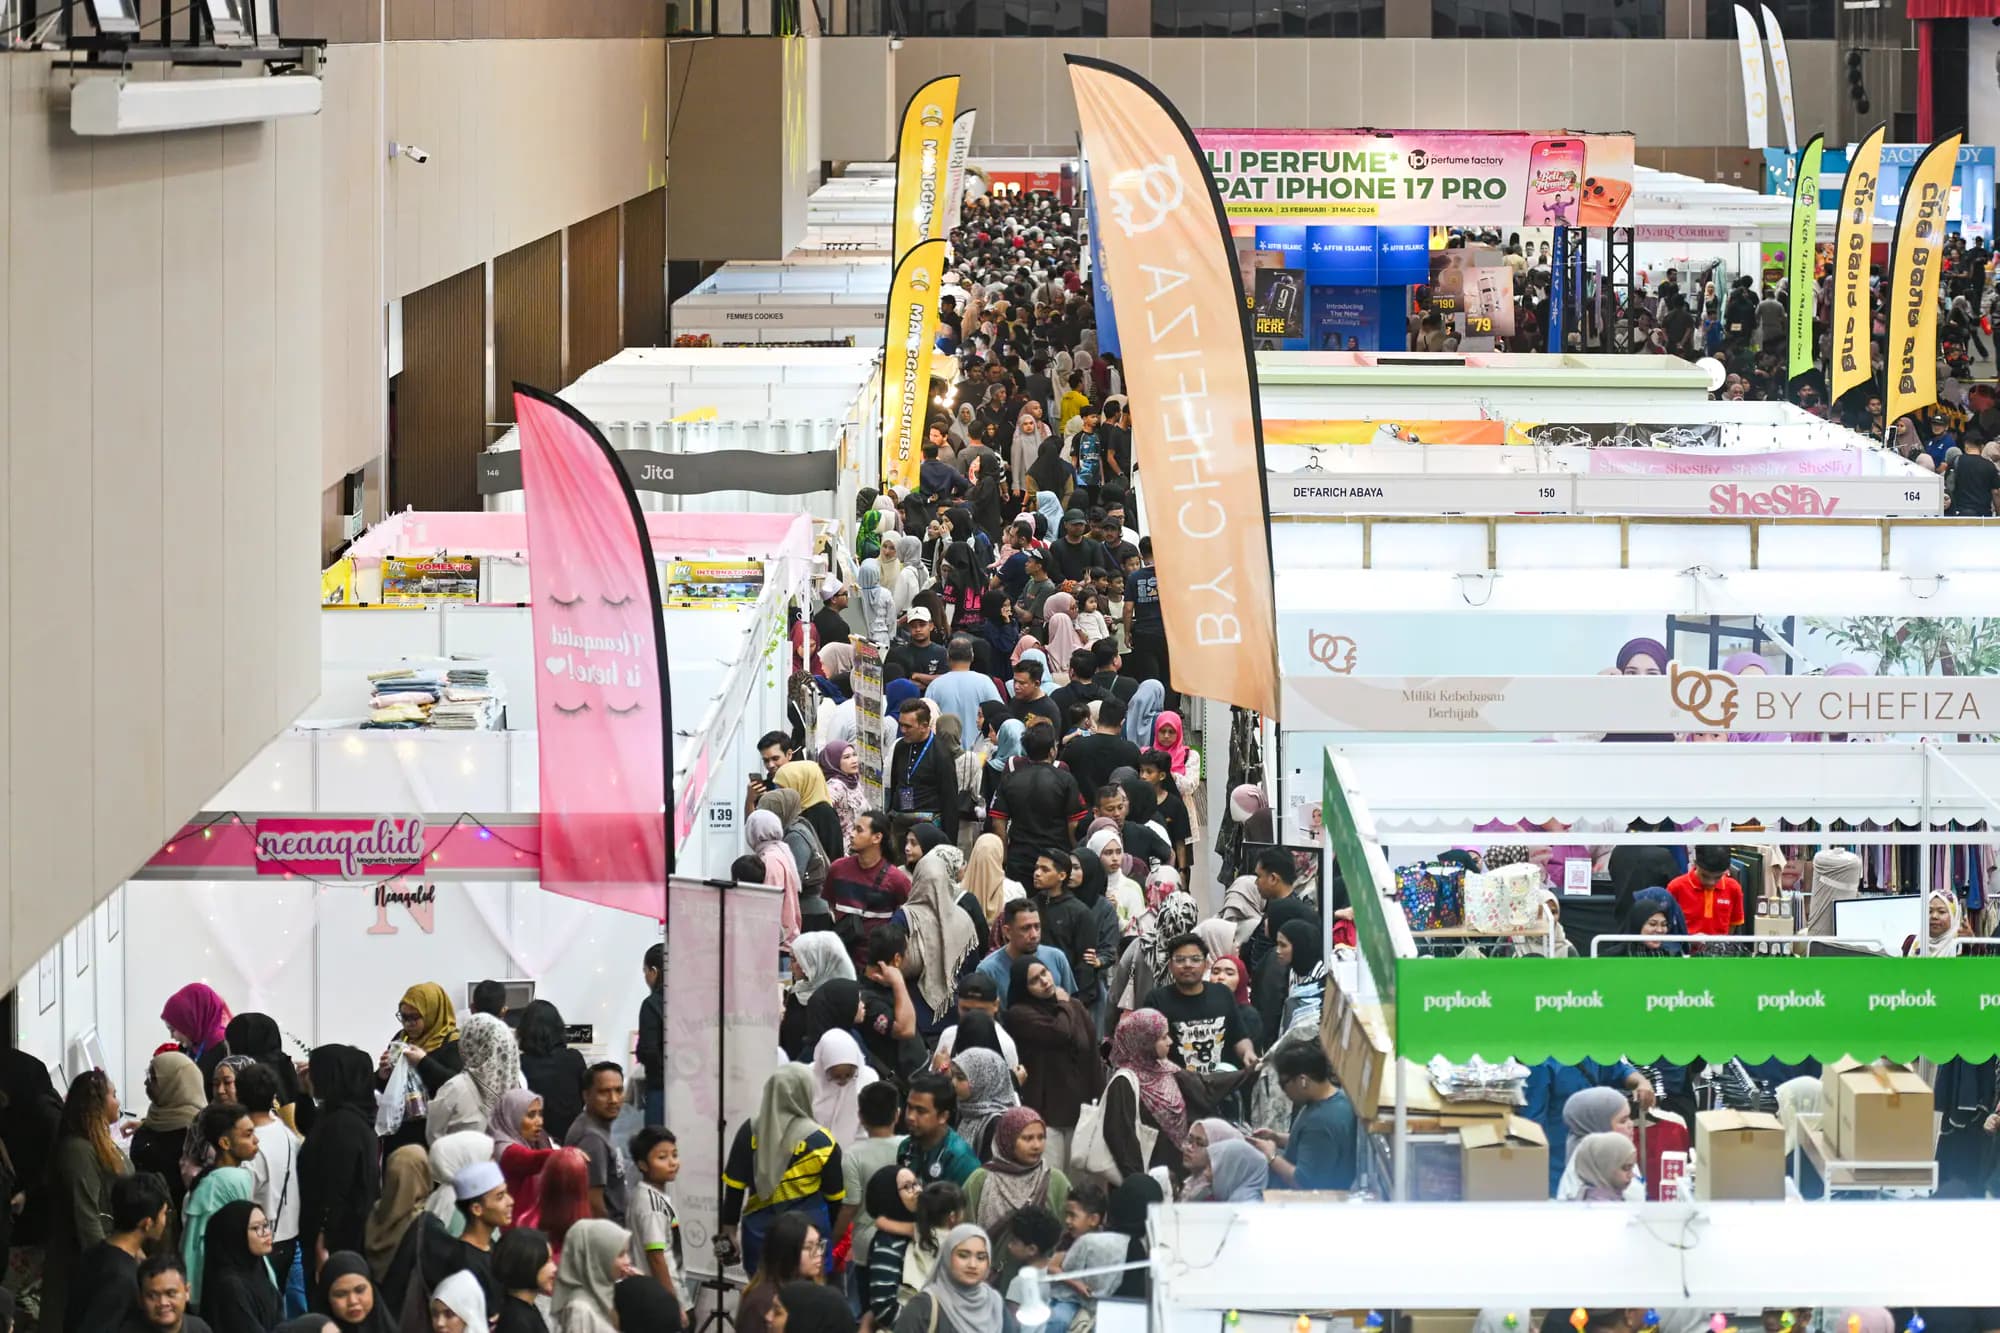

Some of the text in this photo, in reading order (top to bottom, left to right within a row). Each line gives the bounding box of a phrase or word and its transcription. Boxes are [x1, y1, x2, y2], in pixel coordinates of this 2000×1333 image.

[1207, 151, 1231, 173] LI
[1431, 155, 1470, 166] perfume
[1471, 155, 1504, 166] factory
[918, 138, 937, 240] MANGGASU
[1217, 177, 1508, 200] PAT IPHONE 17 PRO
[1227, 206, 1253, 214] FIESTA
[1253, 206, 1274, 214] RAYA
[1340, 206, 1356, 214] MAC
[1357, 206, 1376, 214] 2026
[1323, 244, 1373, 252] AFFIN ISLAMIC
[1389, 243, 1425, 251] AFFIN ISLAMIC
[1256, 323, 1285, 334] HERE
[640, 464, 674, 480] Jita
[1293, 487, 1556, 498] DE'FARICH ABAYA 150
[1709, 483, 1841, 516] SheSlay
[1903, 491, 1921, 502] 164
[1402, 689, 1436, 702] Miliki
[1428, 707, 1479, 721] Berhijab
[1756, 691, 1803, 720] BY
[1819, 691, 1981, 721] CHEFIZA
[261, 819, 420, 876] neaaqalid
[356, 856, 420, 865] Magnetic Eyelashes
[1423, 989, 1492, 1012] poplook
[1534, 989, 1603, 1012] poplook
[1645, 989, 1714, 1012] poplook
[1756, 988, 1825, 1011] poplook
[1867, 988, 1936, 1011] poplook
